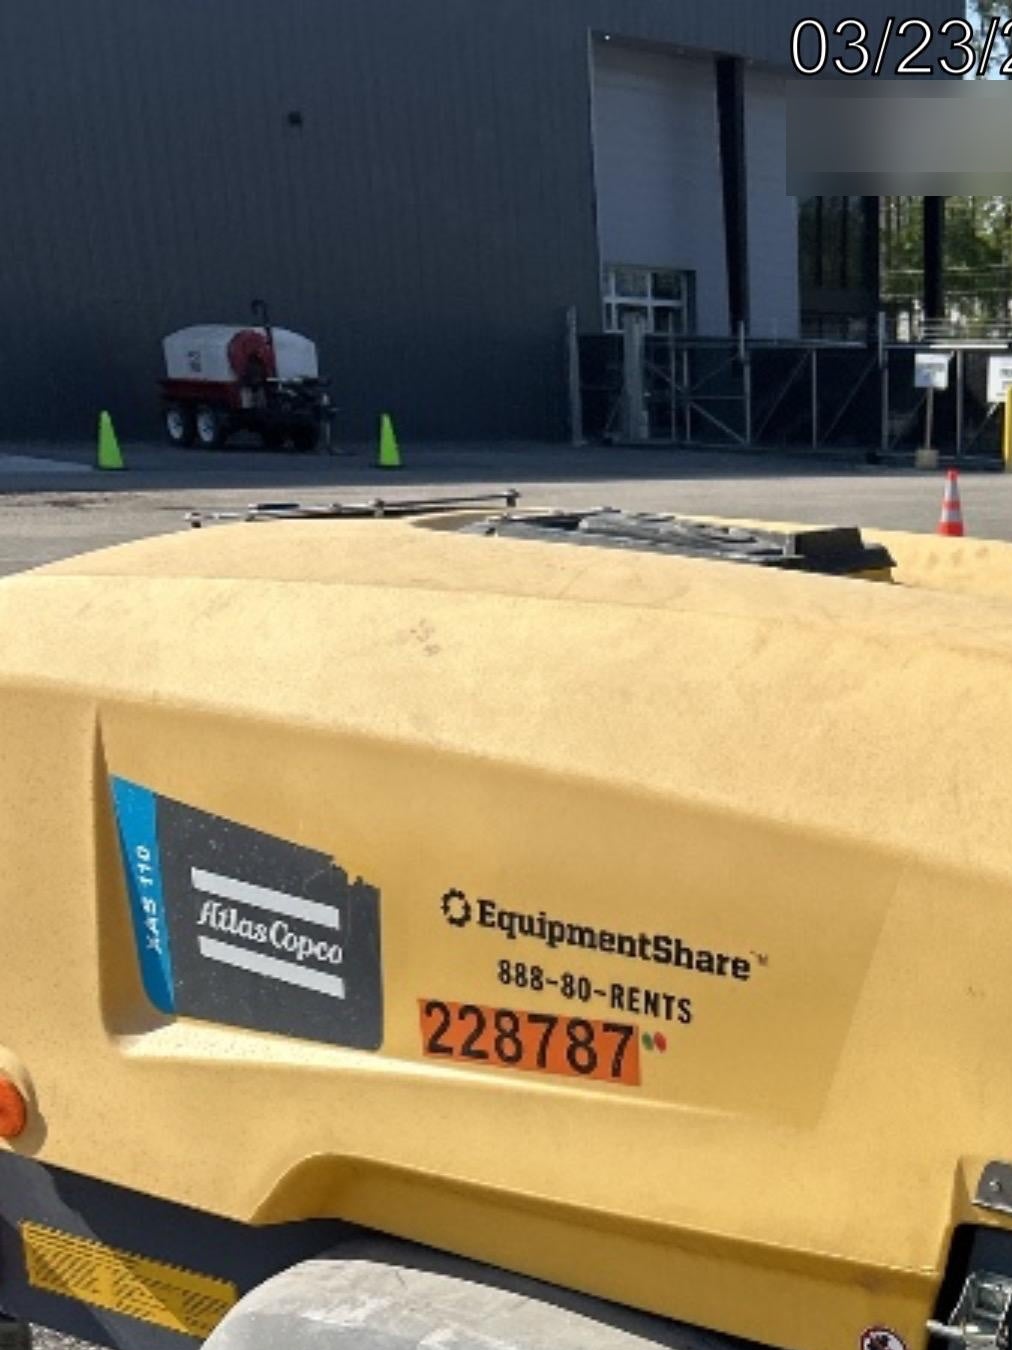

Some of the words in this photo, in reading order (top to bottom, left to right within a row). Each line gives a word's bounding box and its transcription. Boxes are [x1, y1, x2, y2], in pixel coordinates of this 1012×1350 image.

[137, 845, 153, 885] 110
[497, 959, 693, 1024] 888-80-RENTS
[424, 1000, 634, 1078] 228787
